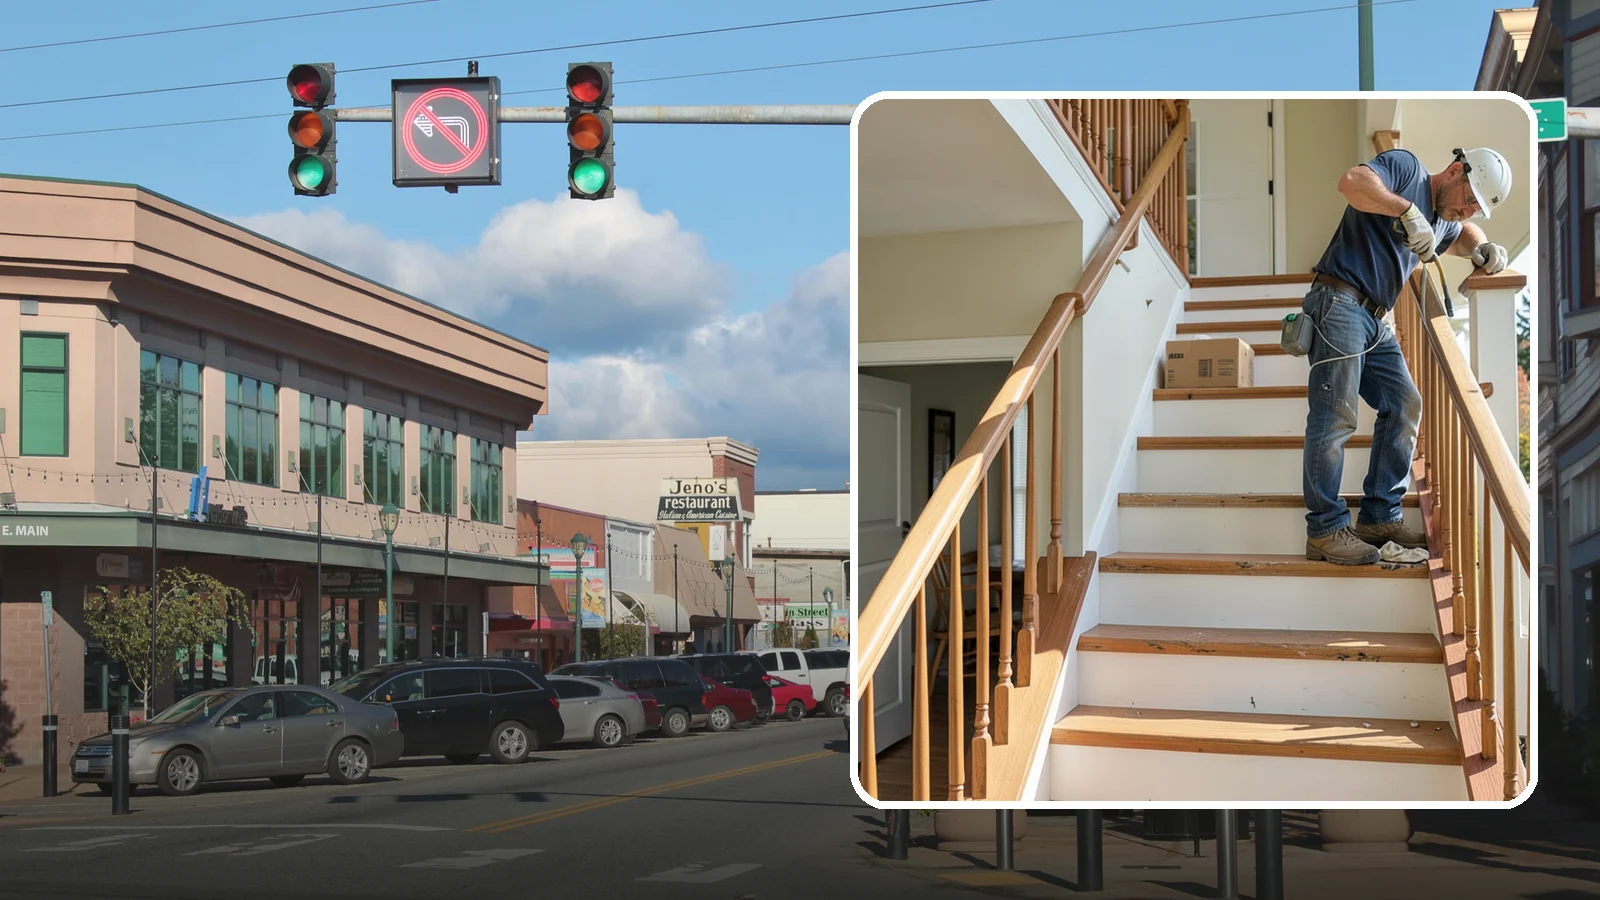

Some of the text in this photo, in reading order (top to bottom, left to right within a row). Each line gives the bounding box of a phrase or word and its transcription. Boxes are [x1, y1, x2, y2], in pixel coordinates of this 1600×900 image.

[670, 480, 727, 494] Jeno's
[665, 497, 731, 509] restaurant
[659, 510, 681, 520] Italian
[686, 509, 714, 520] American
[715, 510, 738, 520] Cuisine
[2, 525, 49, 537] E. MAIN
[785, 608, 828, 617] in Street
[791, 619, 824, 627] lass
